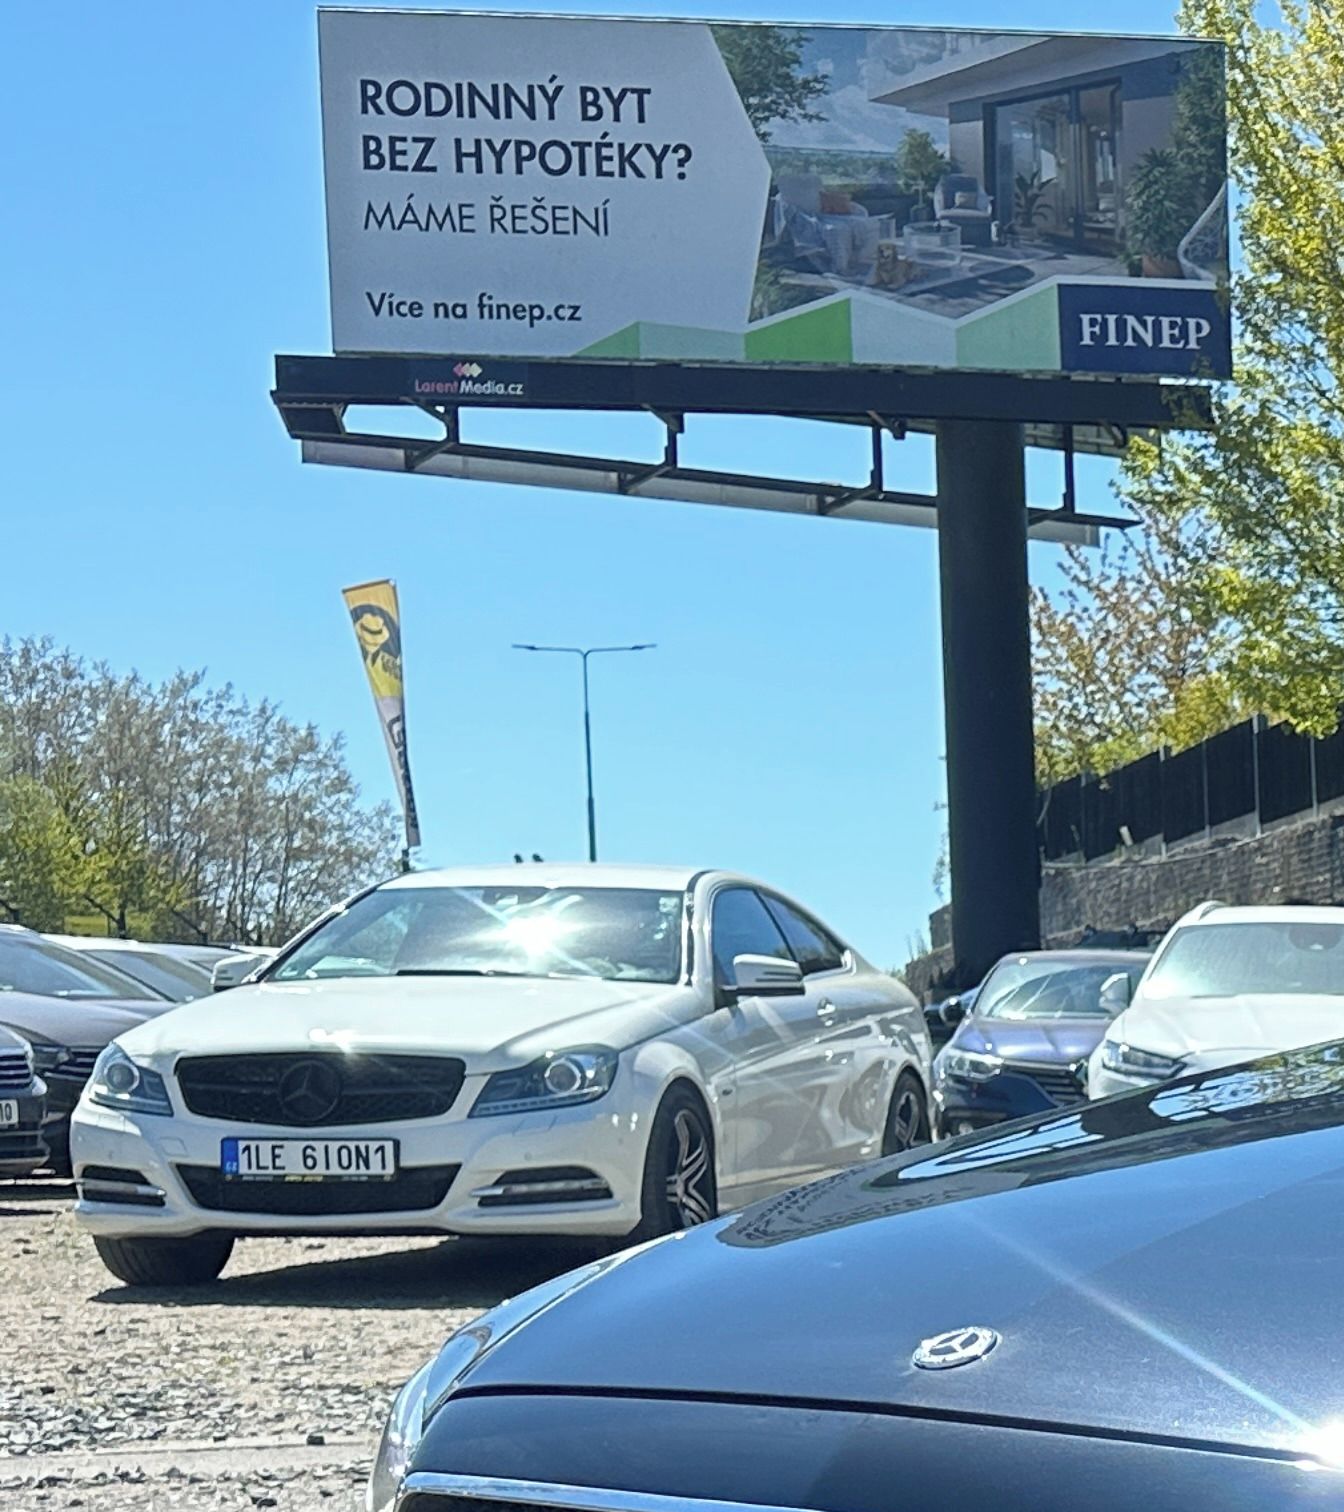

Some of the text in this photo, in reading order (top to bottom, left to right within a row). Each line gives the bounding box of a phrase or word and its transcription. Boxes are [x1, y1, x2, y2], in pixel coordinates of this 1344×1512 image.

[360, 74, 651, 124] RODINNÝ BYT
[362, 131, 693, 181] BEZ HYPOTÉKY?
[363, 193, 611, 237] MÁME ŘEŠENÍ
[365, 291, 582, 328] Více na finep.cz
[1079, 313, 1211, 350] FINEP
[241, 1144, 286, 1171] 1LE
